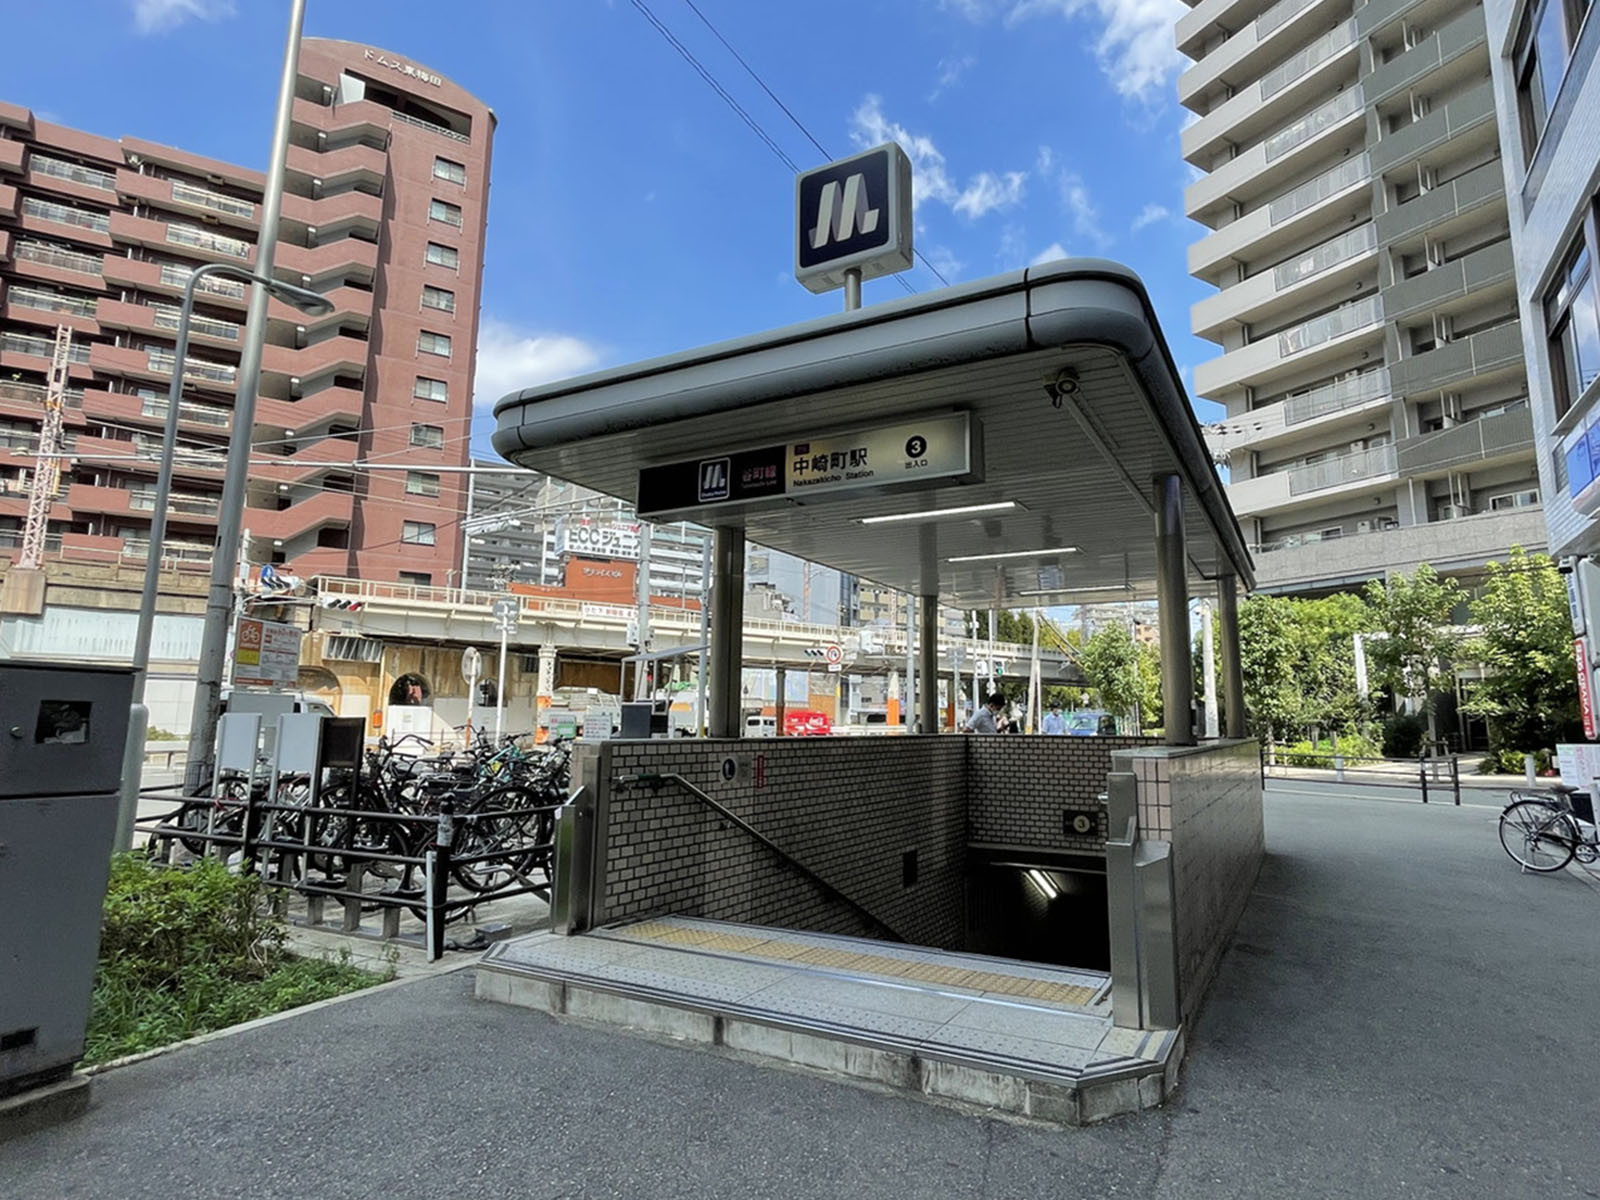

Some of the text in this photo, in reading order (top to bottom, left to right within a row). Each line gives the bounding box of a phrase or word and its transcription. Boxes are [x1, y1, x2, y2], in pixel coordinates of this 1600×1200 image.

[911, 440, 921, 454] 3
[793, 447, 868, 475] 中崎町駅
[905, 459, 928, 469] 出入口
[793, 470, 874, 487] Nakazakicho Station
